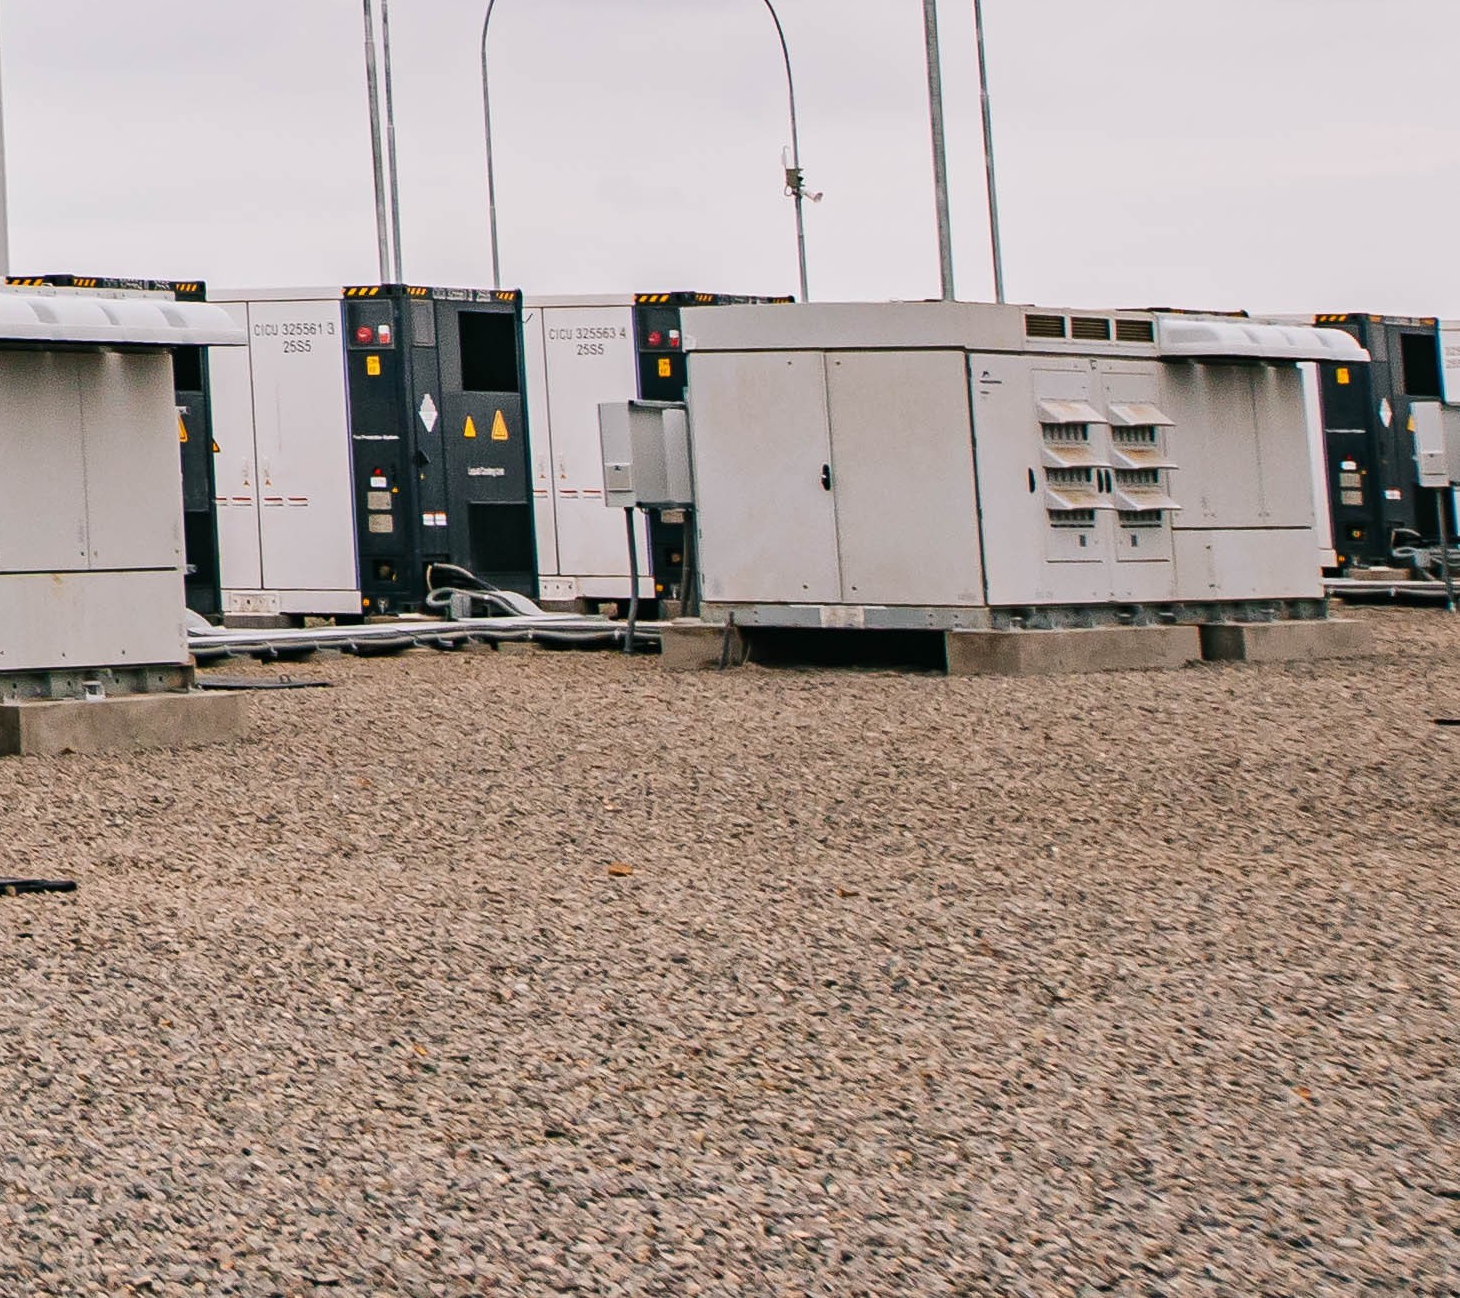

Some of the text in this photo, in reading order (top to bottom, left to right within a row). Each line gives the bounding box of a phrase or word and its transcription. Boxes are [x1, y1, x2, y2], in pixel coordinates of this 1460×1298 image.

[254, 322, 335, 336] CICU 325561 3
[548, 327, 626, 340] CICU 325563 4
[283, 340, 312, 353] 25S5
[577, 343, 604, 355] 25S5
